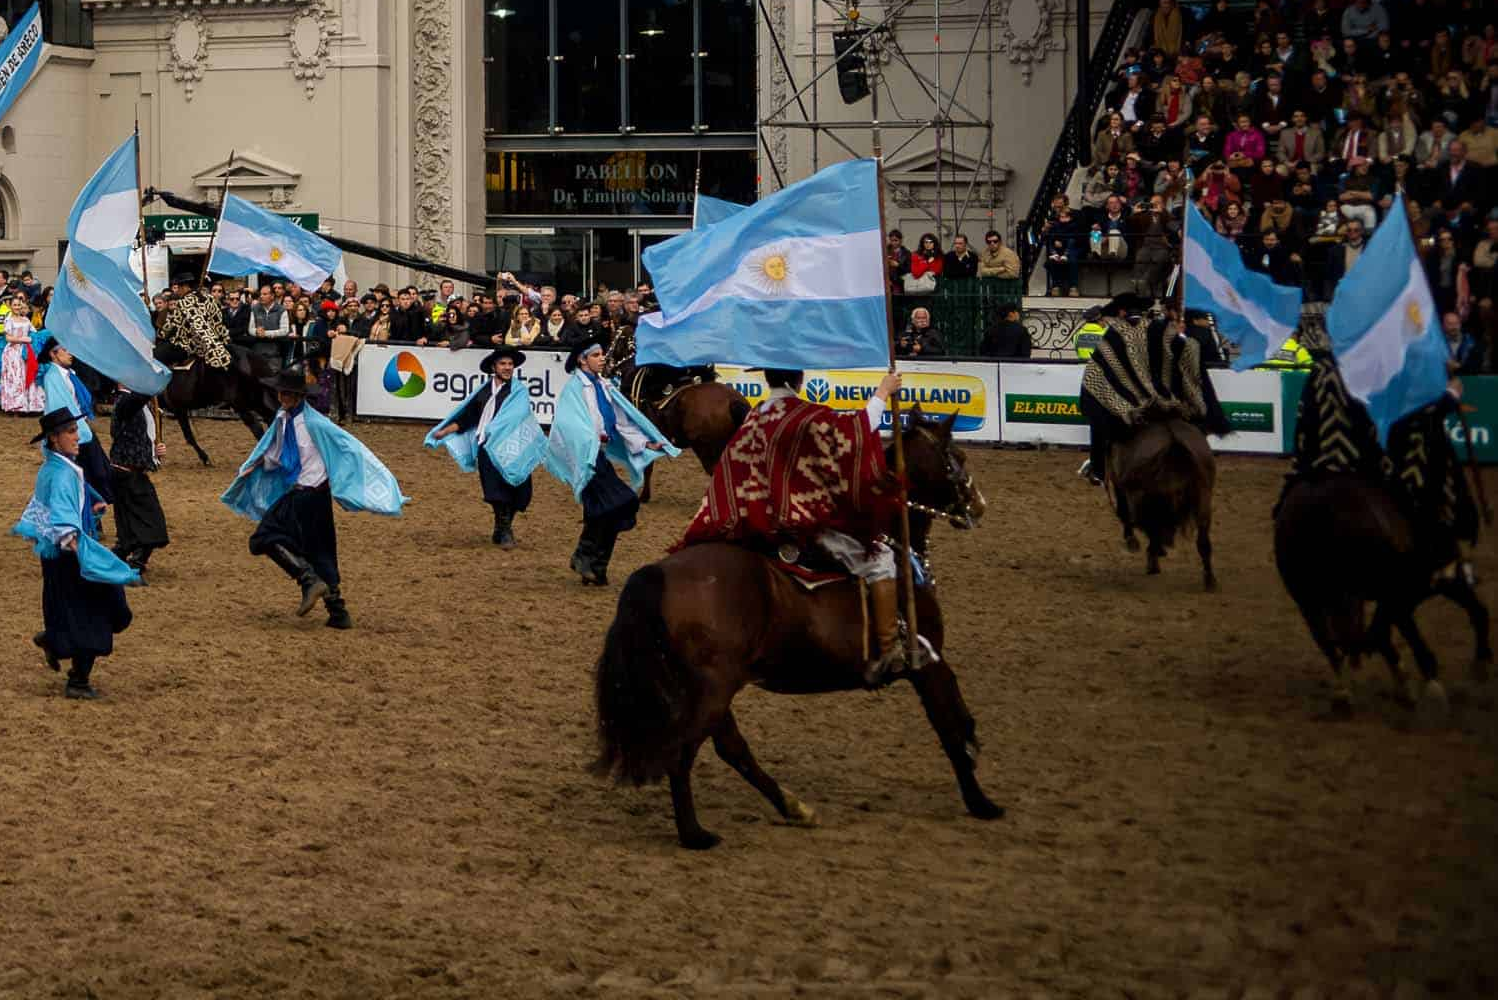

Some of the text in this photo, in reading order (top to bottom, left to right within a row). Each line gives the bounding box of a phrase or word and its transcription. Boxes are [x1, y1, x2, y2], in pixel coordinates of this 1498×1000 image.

[7, 53, 20, 73] DE
[17, 23, 39, 60] ARECO
[554, 188, 577, 204] Dr.
[582, 188, 638, 204] Emilio
[835, 386, 971, 405] NEW OLLAND
